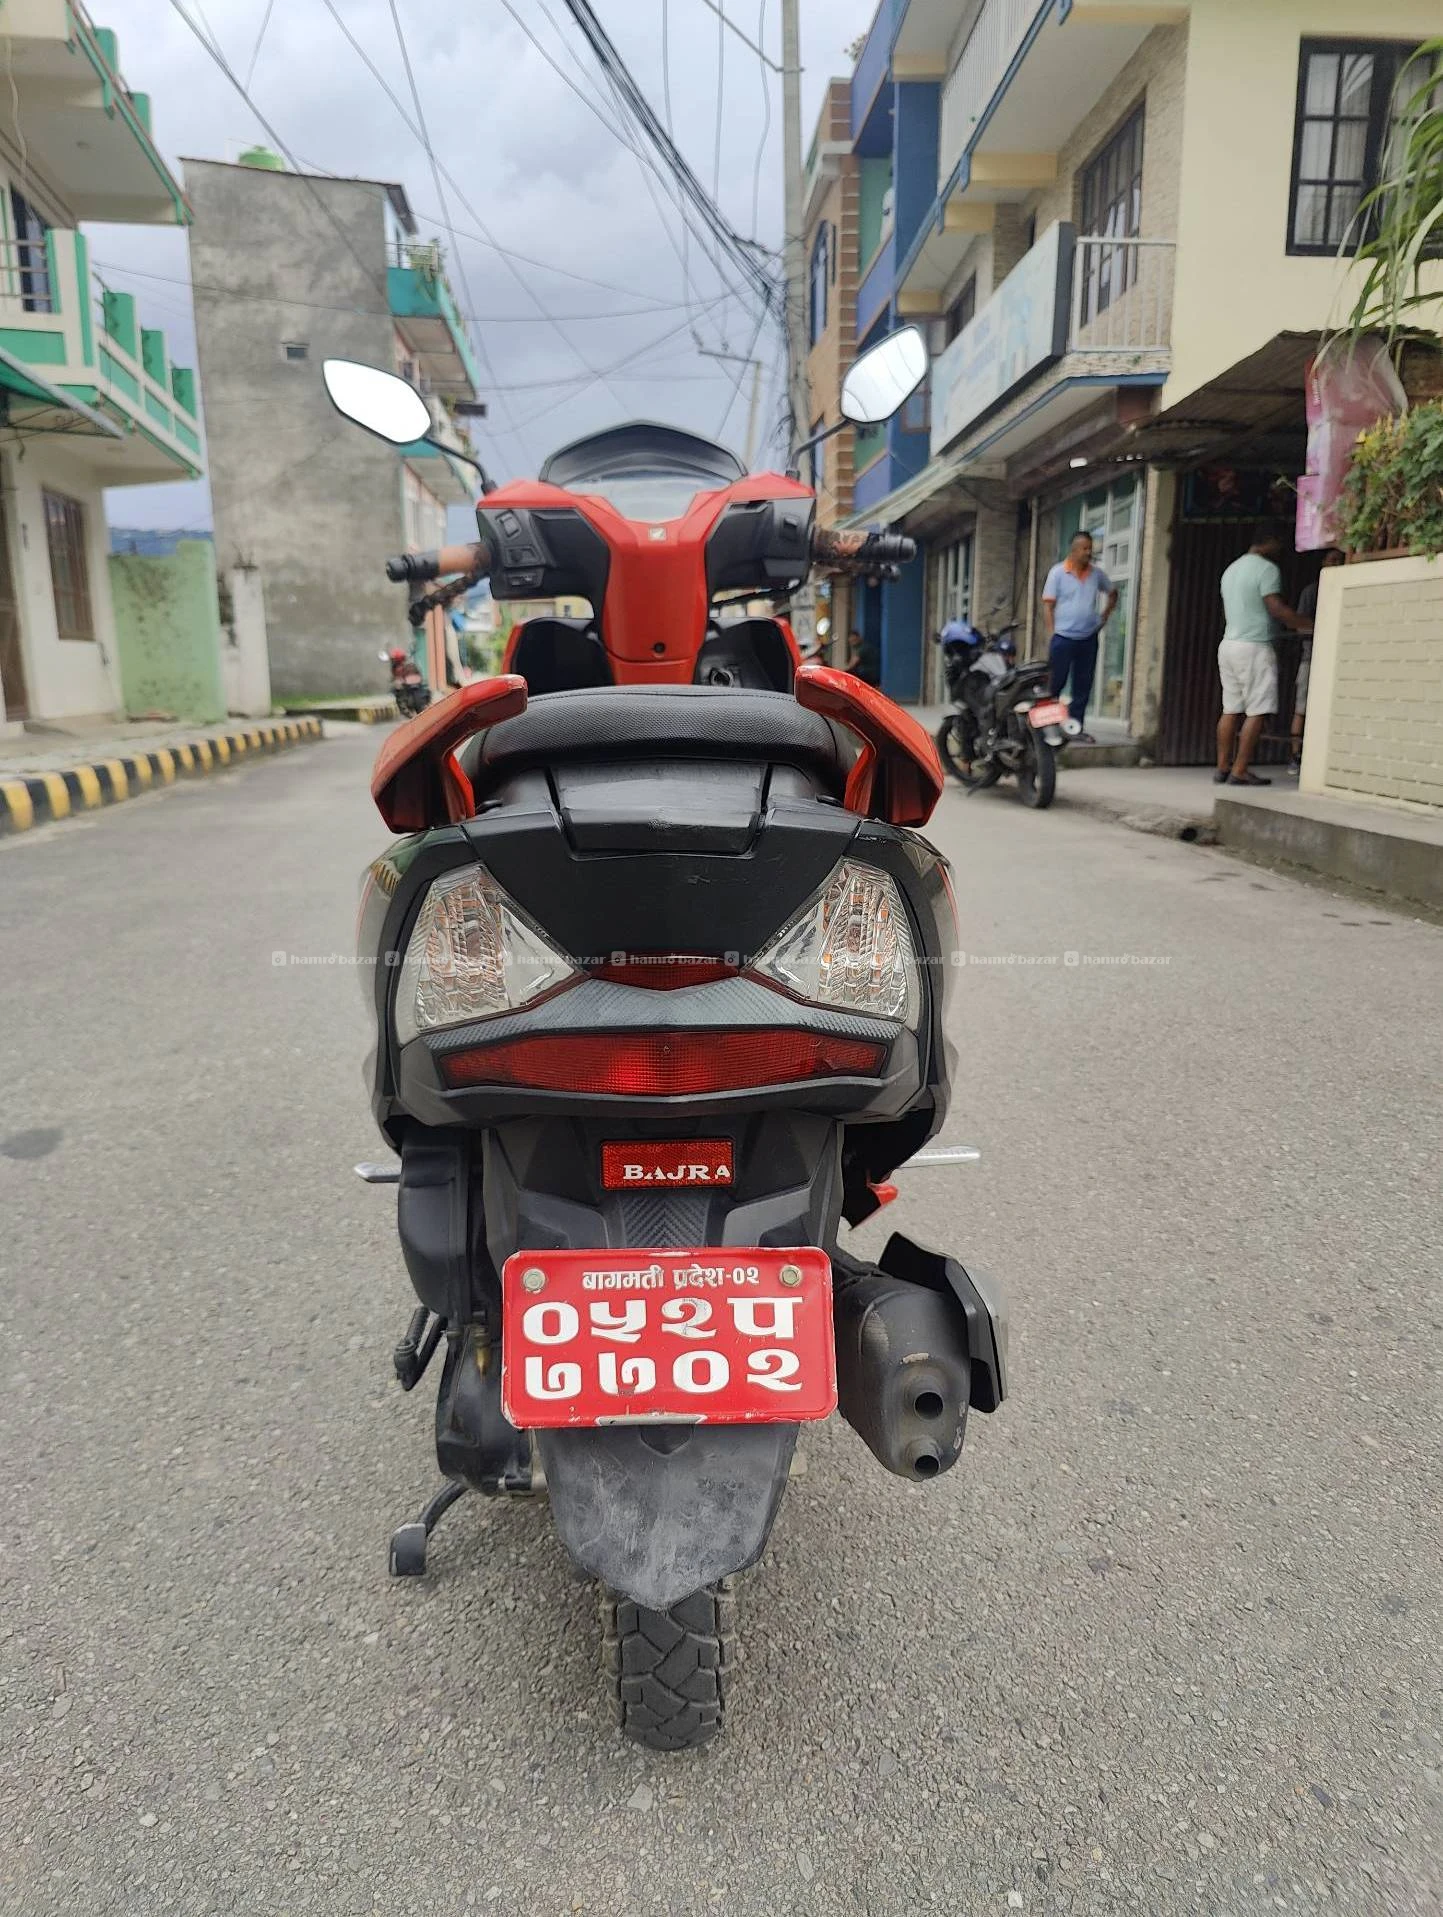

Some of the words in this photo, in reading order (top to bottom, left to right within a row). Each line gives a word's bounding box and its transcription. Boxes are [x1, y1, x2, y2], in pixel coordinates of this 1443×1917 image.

[622, 1164, 731, 1180] BAJRA
[582, 1264, 665, 1290] बागमती
[524, 1348, 803, 1400] ७७०२
